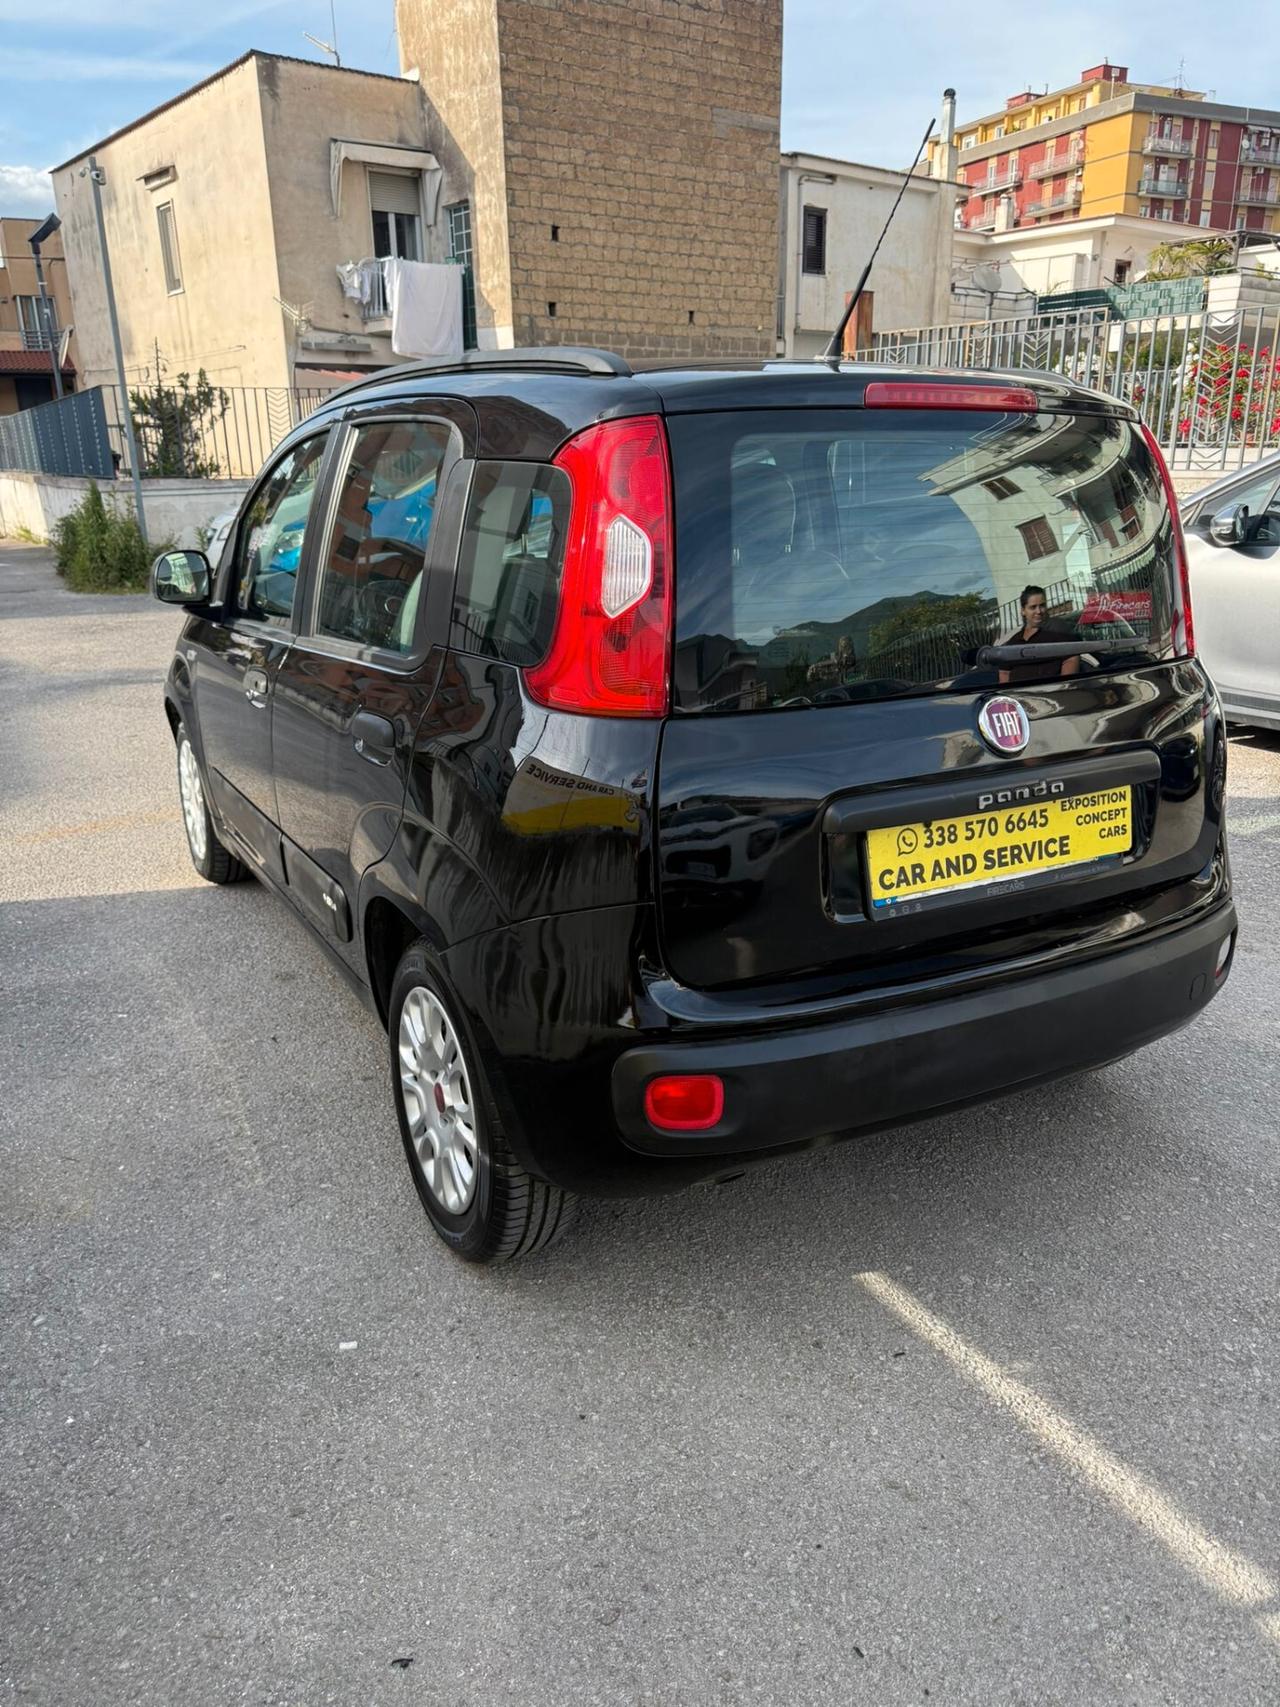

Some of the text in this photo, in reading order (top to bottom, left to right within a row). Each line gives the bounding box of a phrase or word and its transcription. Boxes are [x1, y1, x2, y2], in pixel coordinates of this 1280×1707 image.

[992, 710, 1020, 738] FIAT
[978, 780, 1065, 809] panda
[1060, 791, 1127, 812] EXPOSITION
[924, 808, 1049, 848] 338 570 6645
[1075, 807, 1127, 826] CONCEPT
[1099, 824, 1127, 839] CARS
[879, 835, 1070, 890] CAR AND SERVICE
